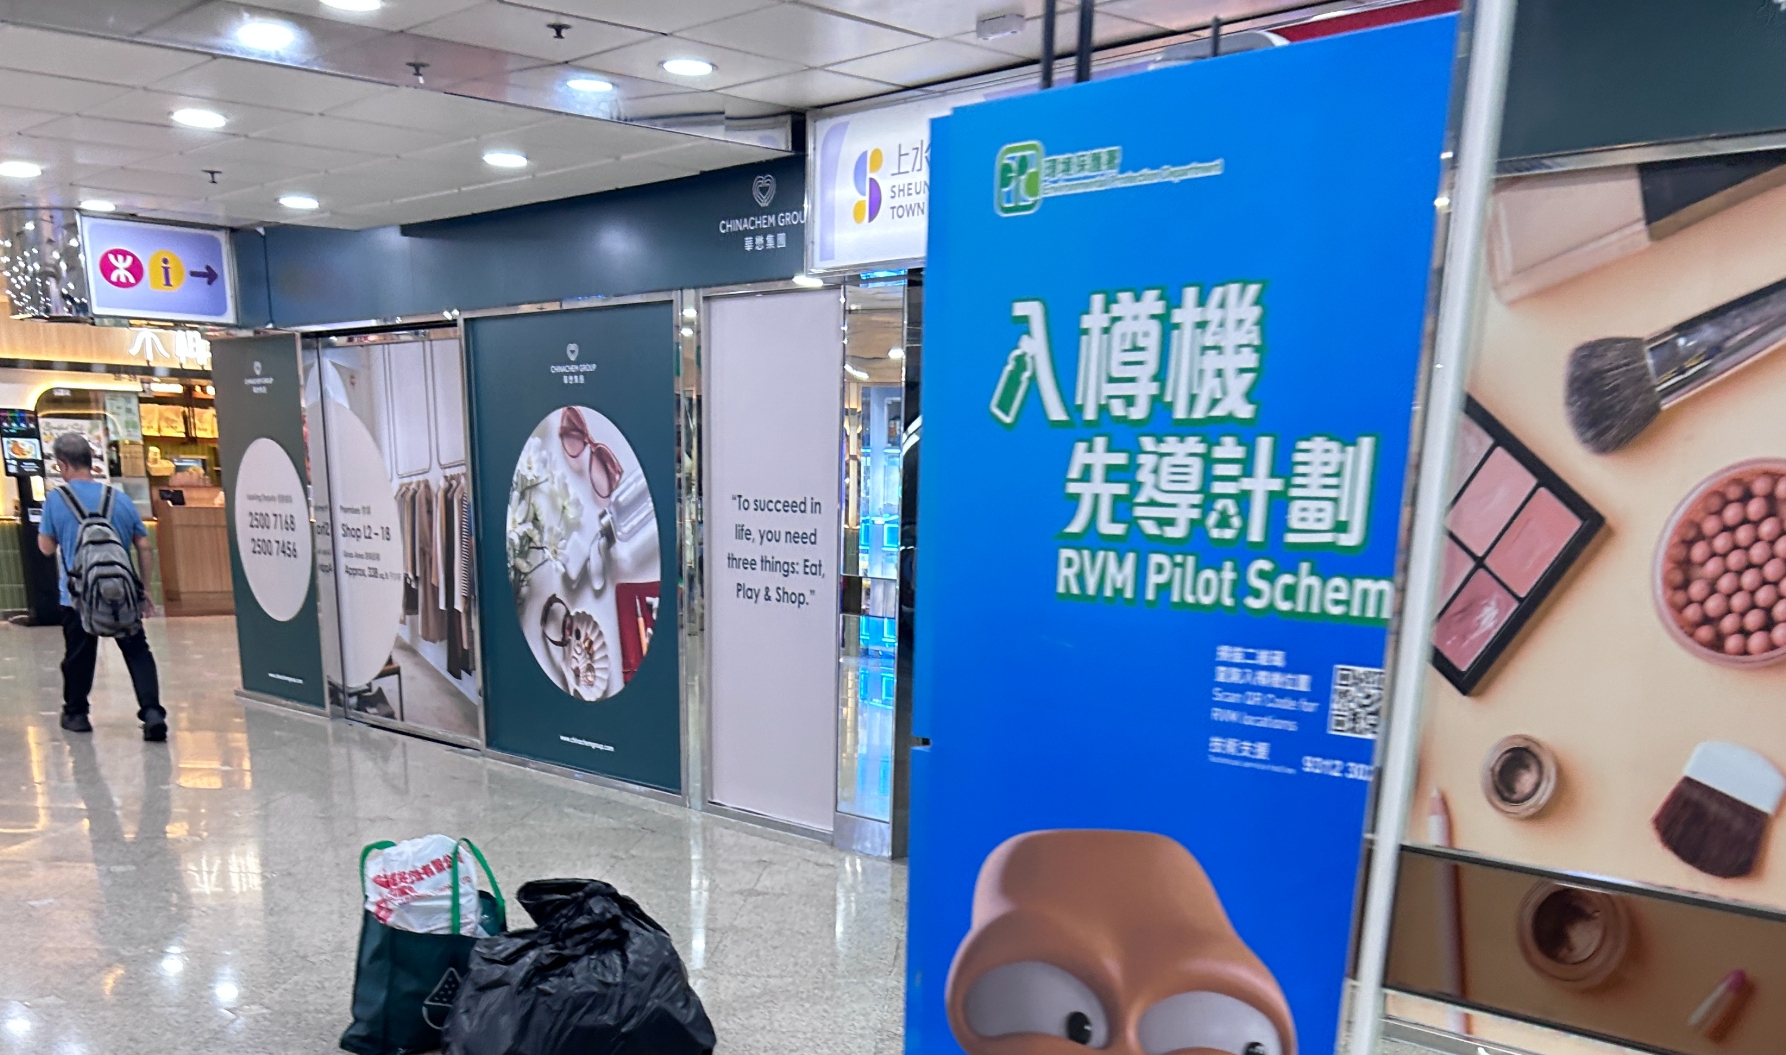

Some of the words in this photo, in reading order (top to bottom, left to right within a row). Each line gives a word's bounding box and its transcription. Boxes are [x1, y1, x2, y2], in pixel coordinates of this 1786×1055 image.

[890, 180, 929, 199] SHEUN
[890, 202, 925, 220] TOWN
[719, 213, 775, 234] CHINACHEM
[778, 211, 805, 227] GROU
[990, 282, 1264, 423] 入樽機
[1063, 435, 1376, 547] 先導計劃
[753, 497, 807, 514] succeed
[810, 497, 822, 514] in
[249, 511, 271, 530] 2500
[341, 523, 362, 541] Shop
[363, 525, 373, 540] L2
[735, 524, 755, 543] life,
[758, 529, 781, 546] you
[785, 528, 817, 545] need
[251, 538, 273, 556] 2500
[274, 540, 298, 558] 7456
[727, 552, 757, 571] three
[760, 555, 799, 578] things:
[803, 559, 825, 578] Eat,
[736, 583, 761, 604] Play
[764, 586, 772, 601] &
[1056, 548, 1137, 599] RVM
[1145, 554, 1237, 607] Pilot
[1244, 558, 1393, 619] Schem
